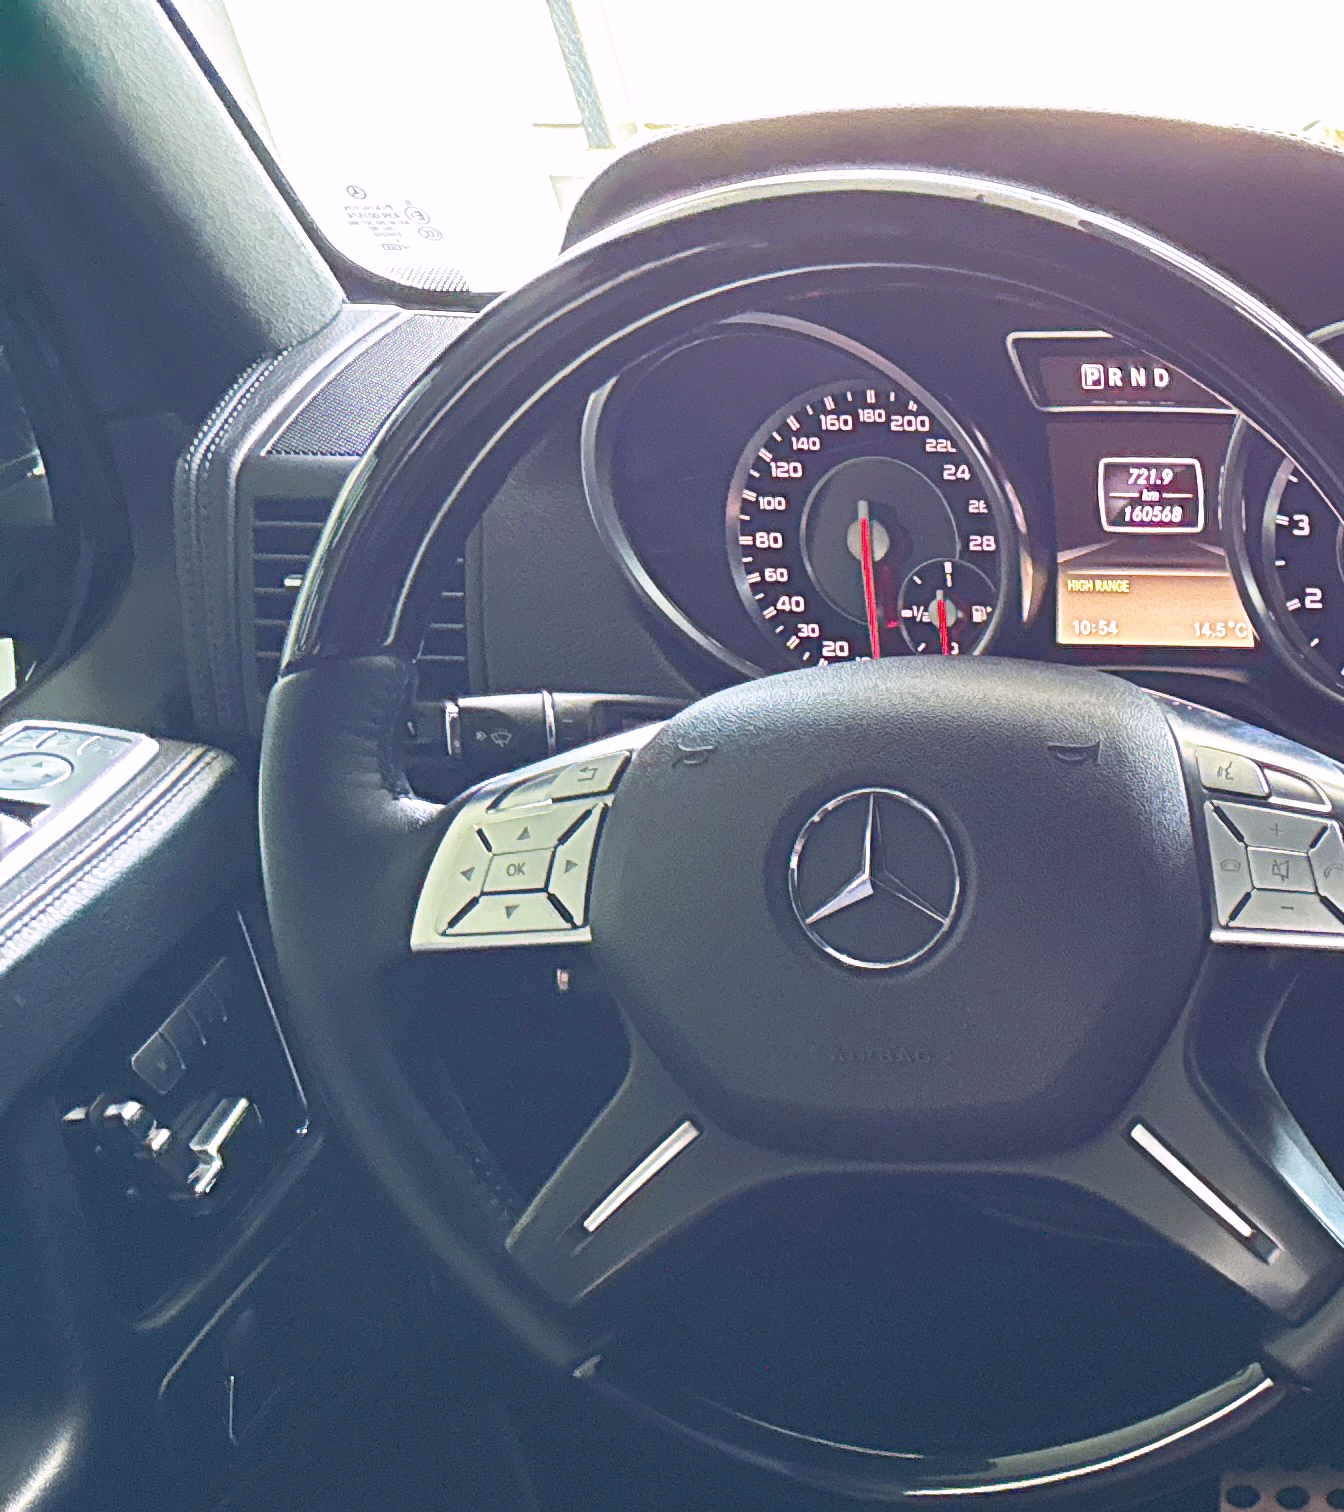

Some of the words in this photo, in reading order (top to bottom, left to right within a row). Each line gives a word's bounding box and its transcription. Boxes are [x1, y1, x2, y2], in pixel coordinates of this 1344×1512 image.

[1086, 367, 1099, 387] P
[1108, 367, 1123, 387] R
[1130, 367, 1147, 387] N
[1154, 367, 1169, 387] D
[820, 415, 853, 430] 160
[858, 409, 885, 422] 180
[890, 416, 929, 431] 200
[791, 437, 820, 450] 140
[770, 462, 802, 477] 120
[1127, 468, 1173, 485] 721.9
[1142, 487, 1159, 502] km
[758, 497, 785, 510] 100
[1124, 506, 1182, 523] 160568
[1292, 514, 1311, 536] 3
[755, 532, 783, 548] 80
[765, 568, 788, 582] 60
[1067, 579, 1093, 593] HIGH
[1095, 580, 1130, 594] RANGE
[777, 596, 804, 612] 40
[1304, 588, 1323, 609] 2
[797, 624, 819, 637] 30
[1072, 620, 1118, 635] 10:54
[822, 641, 848, 656] 20
[504, 861, 526, 878] OK
